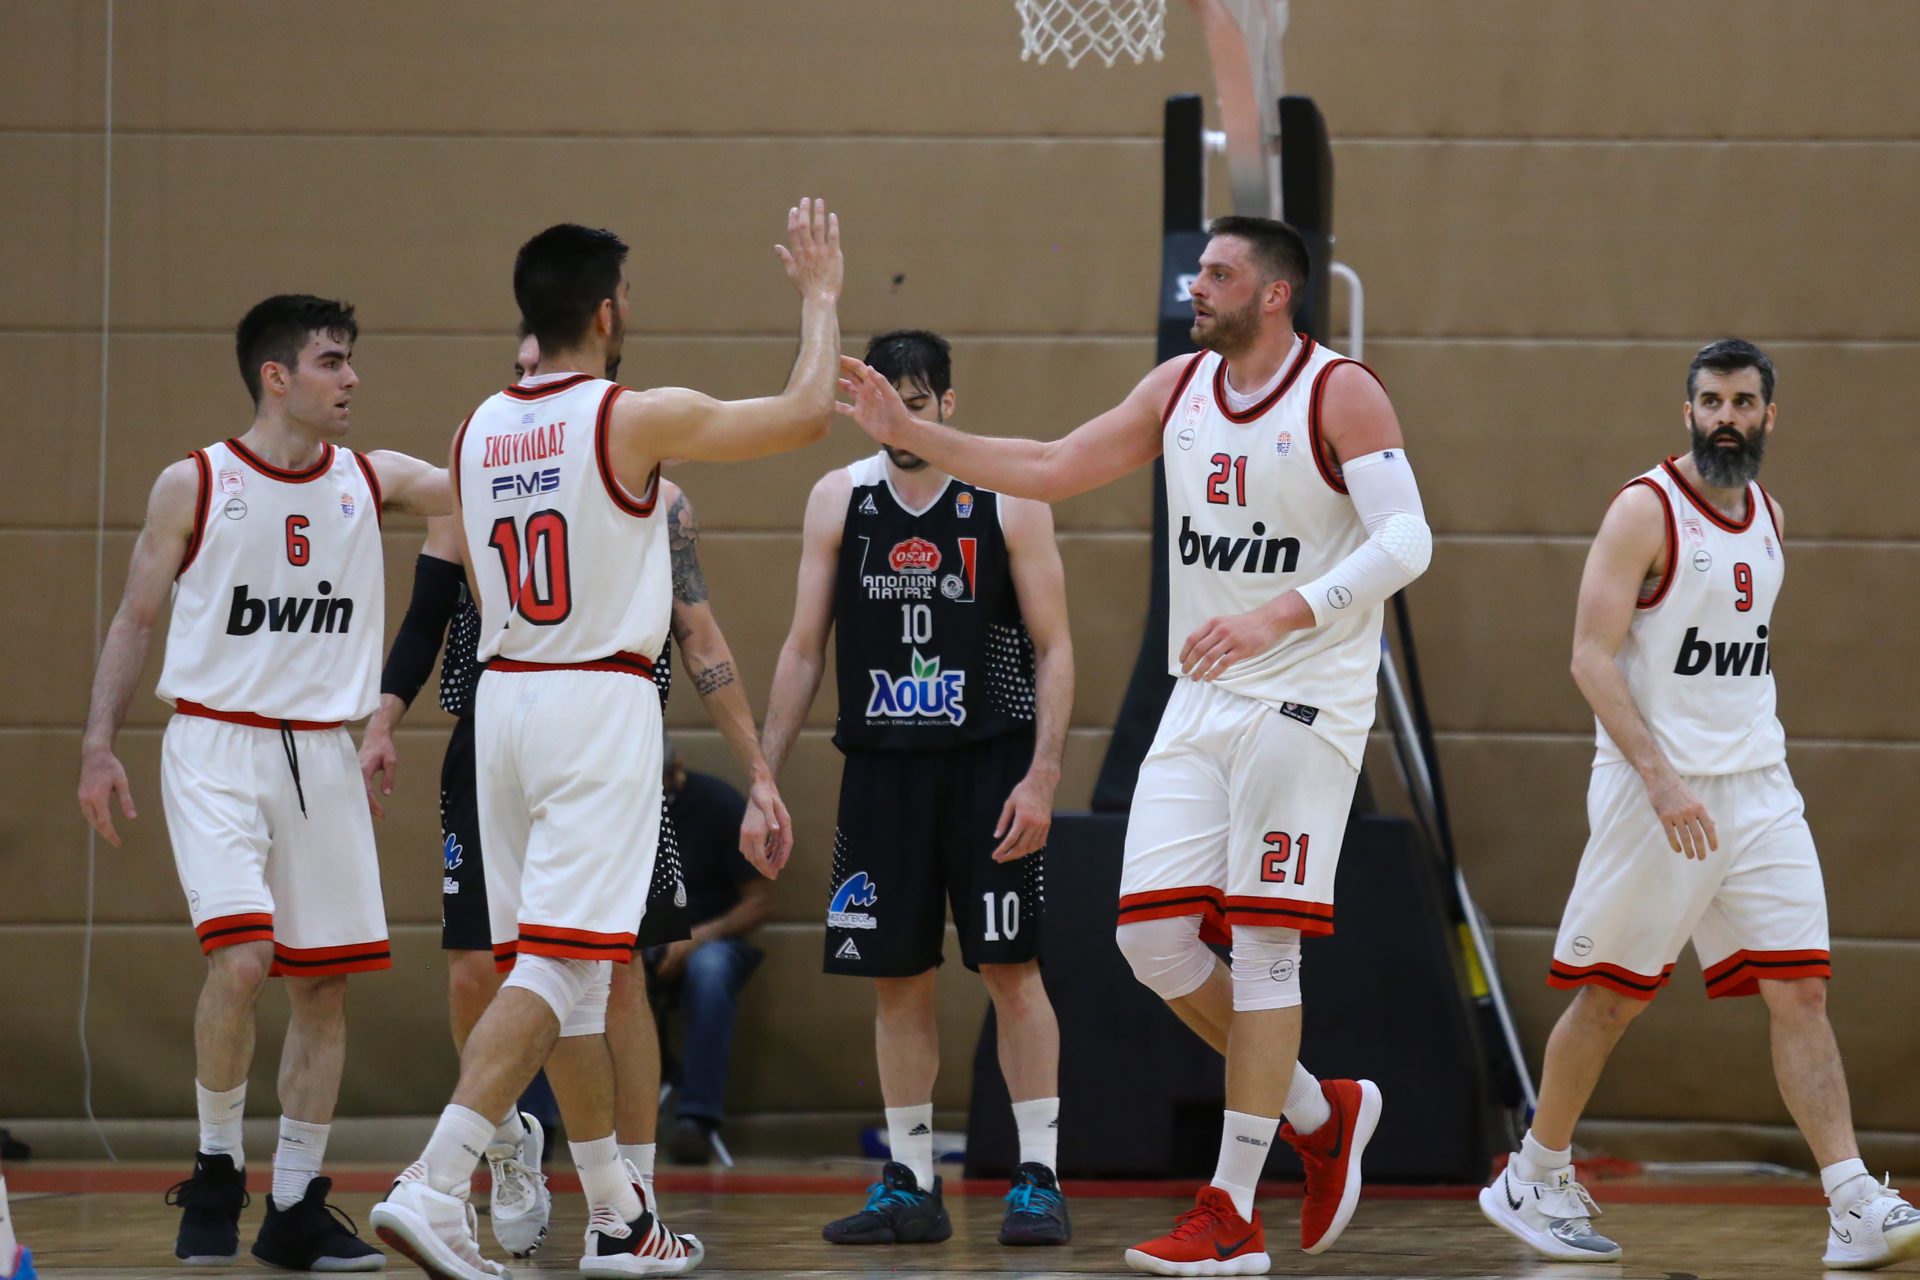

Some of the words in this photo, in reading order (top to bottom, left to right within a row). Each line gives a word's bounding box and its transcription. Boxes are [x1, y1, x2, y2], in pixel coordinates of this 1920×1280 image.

[483, 422, 566, 468] ΣΚΟΥΛΙΔΑΣ
[492, 468, 561, 499] FMS
[1207, 452, 1248, 507] 21
[286, 514, 311, 567] 6
[1178, 515, 1301, 574] bwin
[488, 508, 572, 629] 10
[868, 588, 932, 600] ΠΑΤΡΑΣ
[1733, 562, 1754, 612] 9
[226, 580, 354, 636] bwin
[900, 604, 933, 644] 10
[1673, 624, 1770, 677] bwi
[866, 669, 967, 727] λουξ
[1260, 830, 1310, 886] 21
[982, 891, 1020, 942] 10
